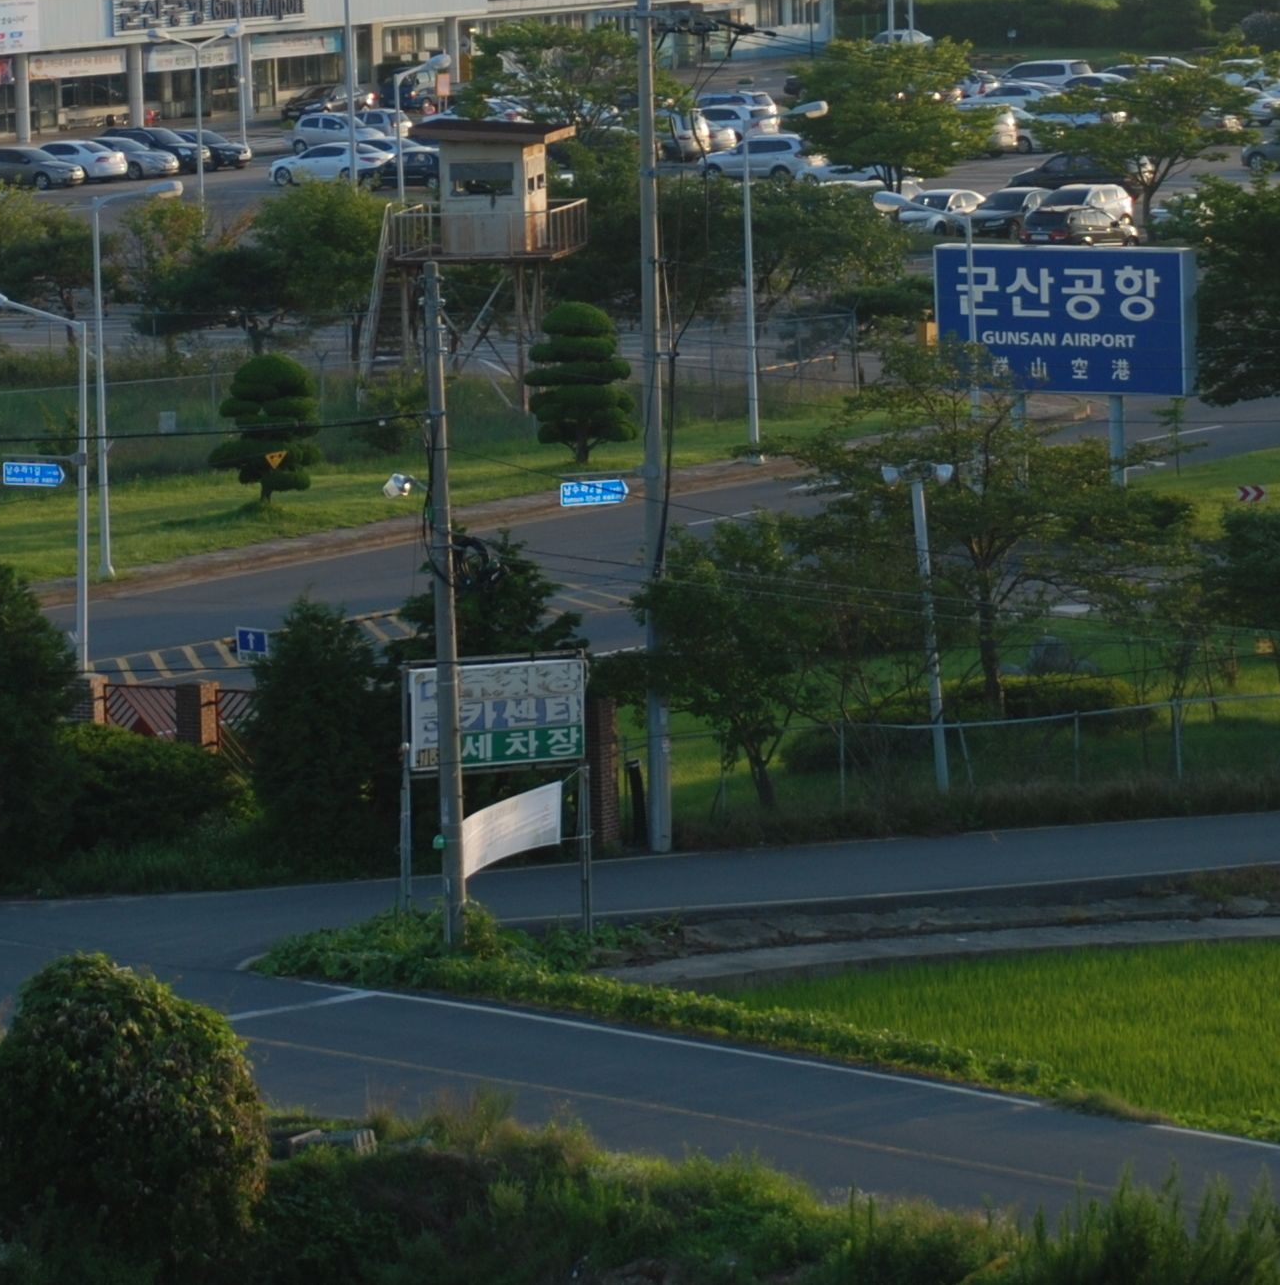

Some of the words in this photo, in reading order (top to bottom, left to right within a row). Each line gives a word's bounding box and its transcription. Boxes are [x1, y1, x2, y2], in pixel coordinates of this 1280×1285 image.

[956, 265, 1161, 322] 군산공항
[982, 330, 1056, 347] GUNSAN
[1061, 332, 1136, 348] AIRPORT
[463, 727, 580, 761] 세차장
